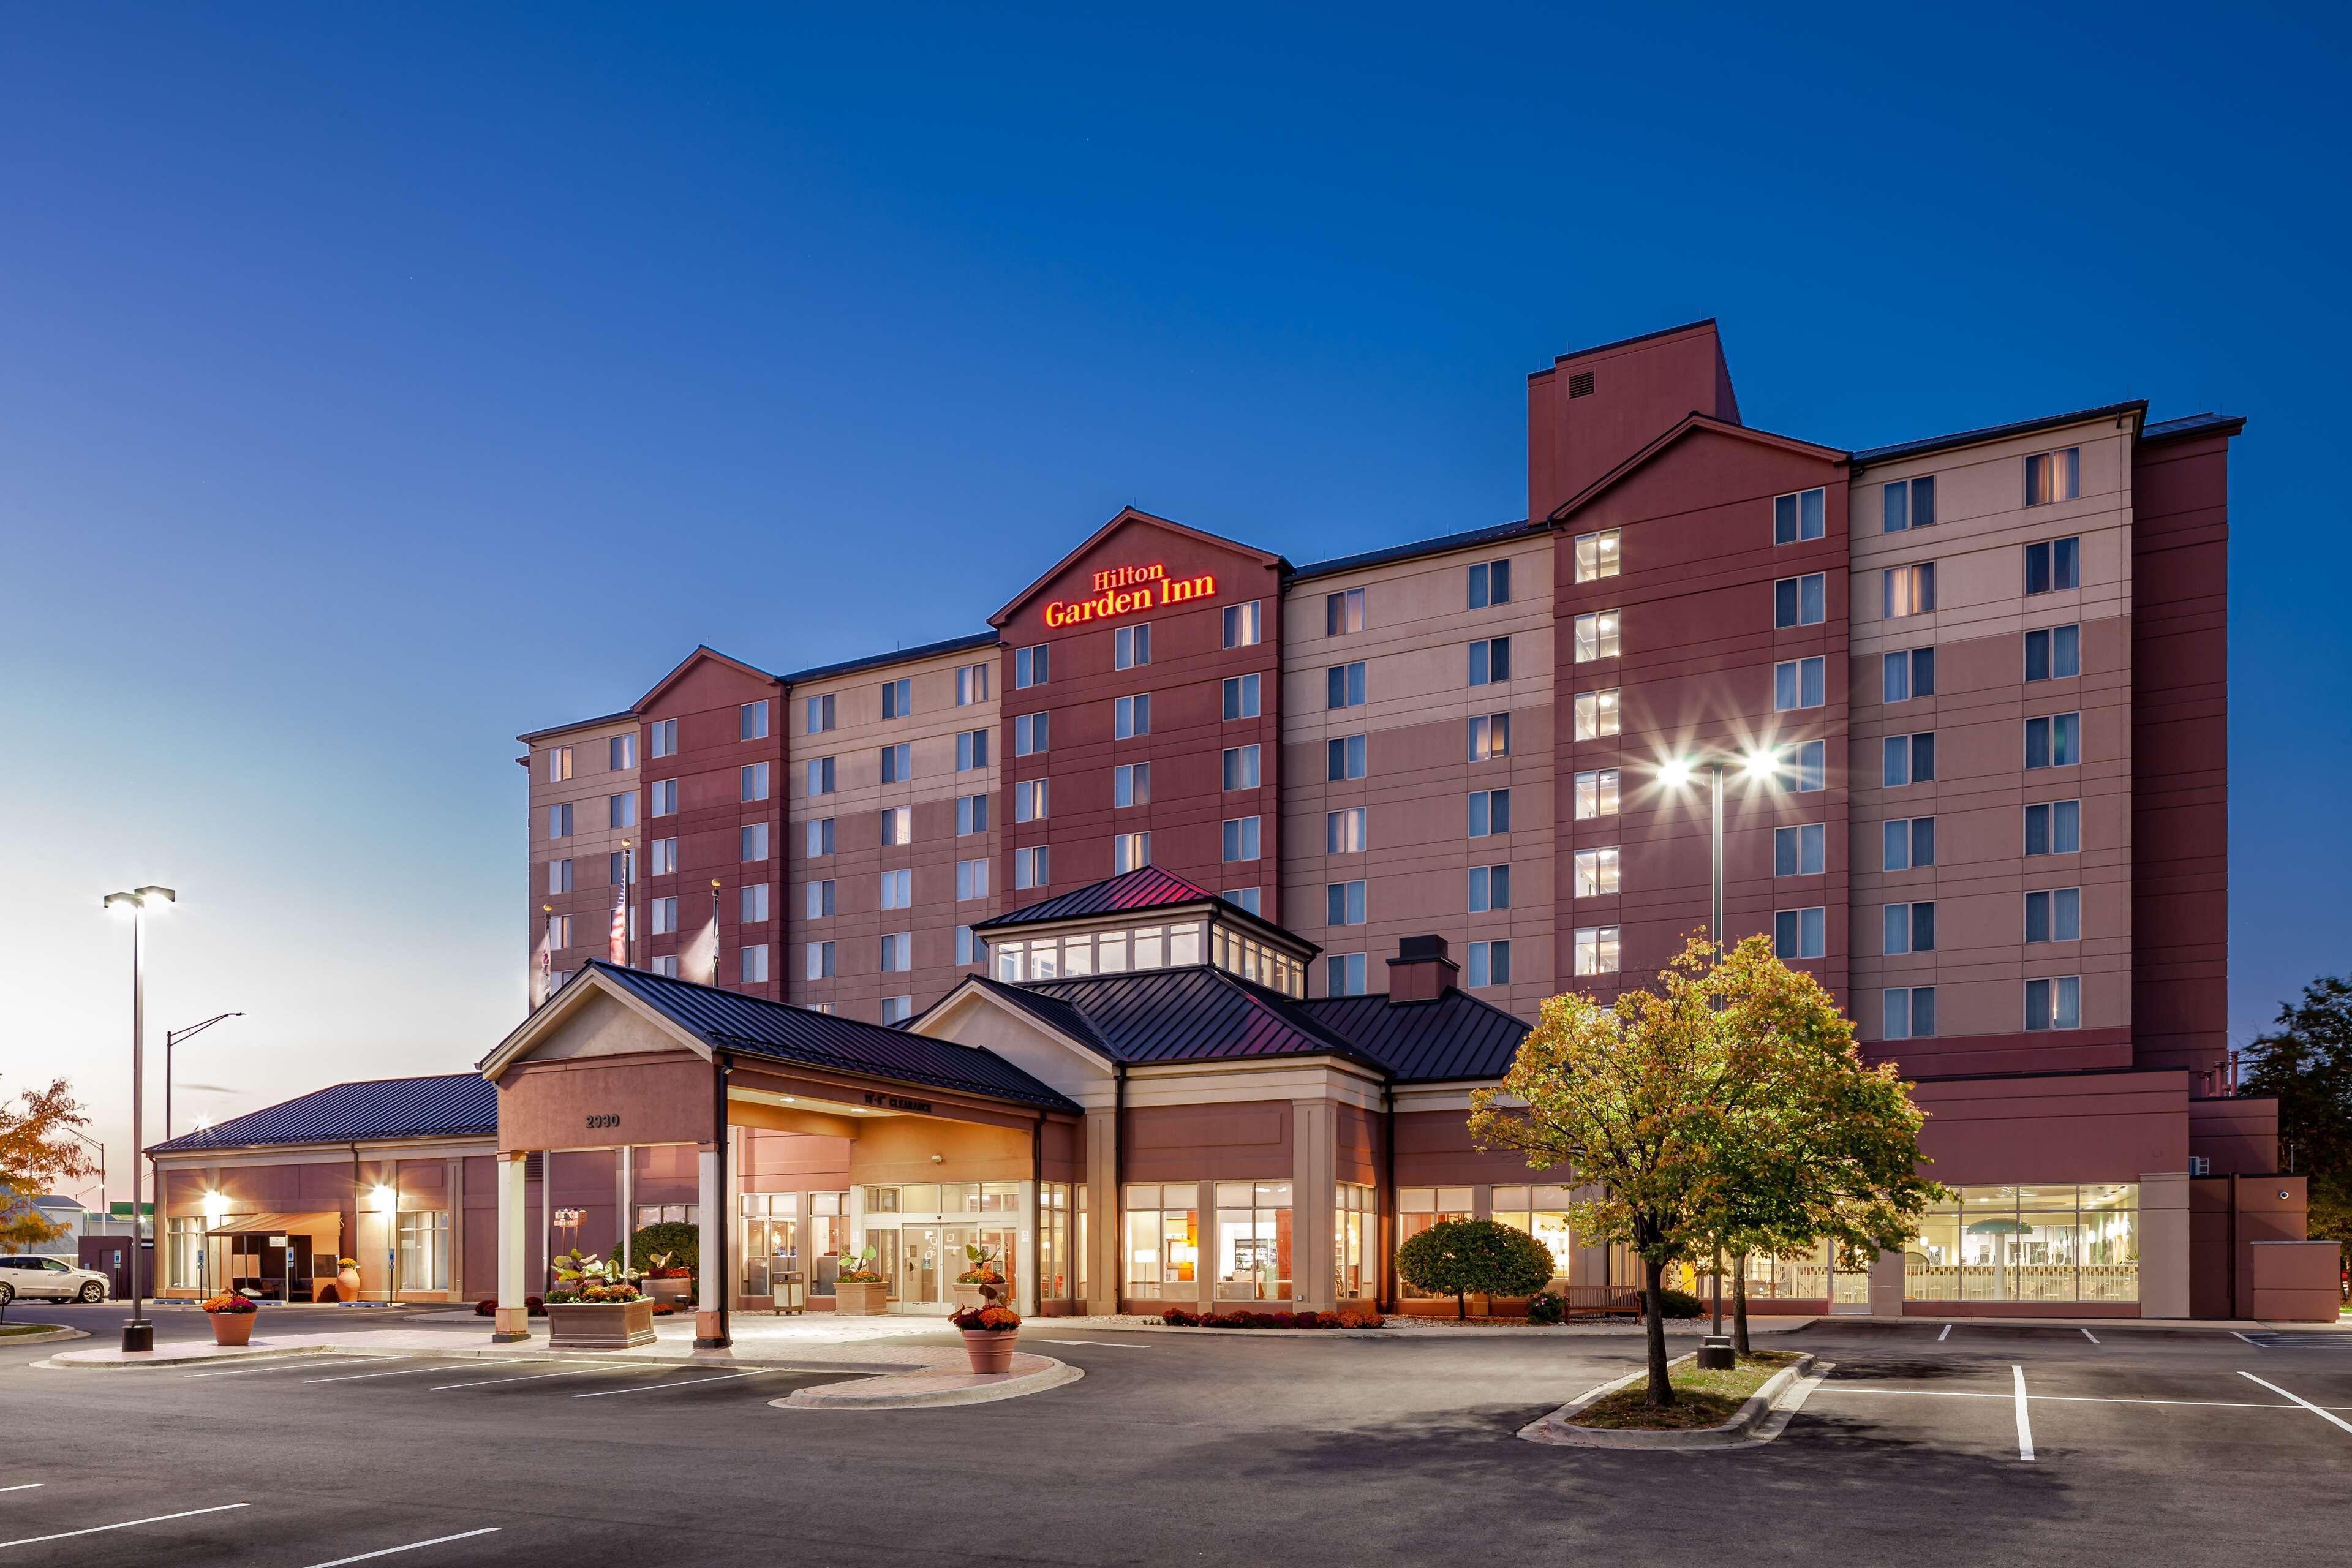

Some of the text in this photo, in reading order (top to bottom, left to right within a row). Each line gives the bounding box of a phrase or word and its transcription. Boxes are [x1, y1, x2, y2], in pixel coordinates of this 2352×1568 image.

[1093, 564, 1164, 592] Hilton
[1046, 575, 1215, 627] Garden Inn
[586, 1114, 620, 1128] 2930
